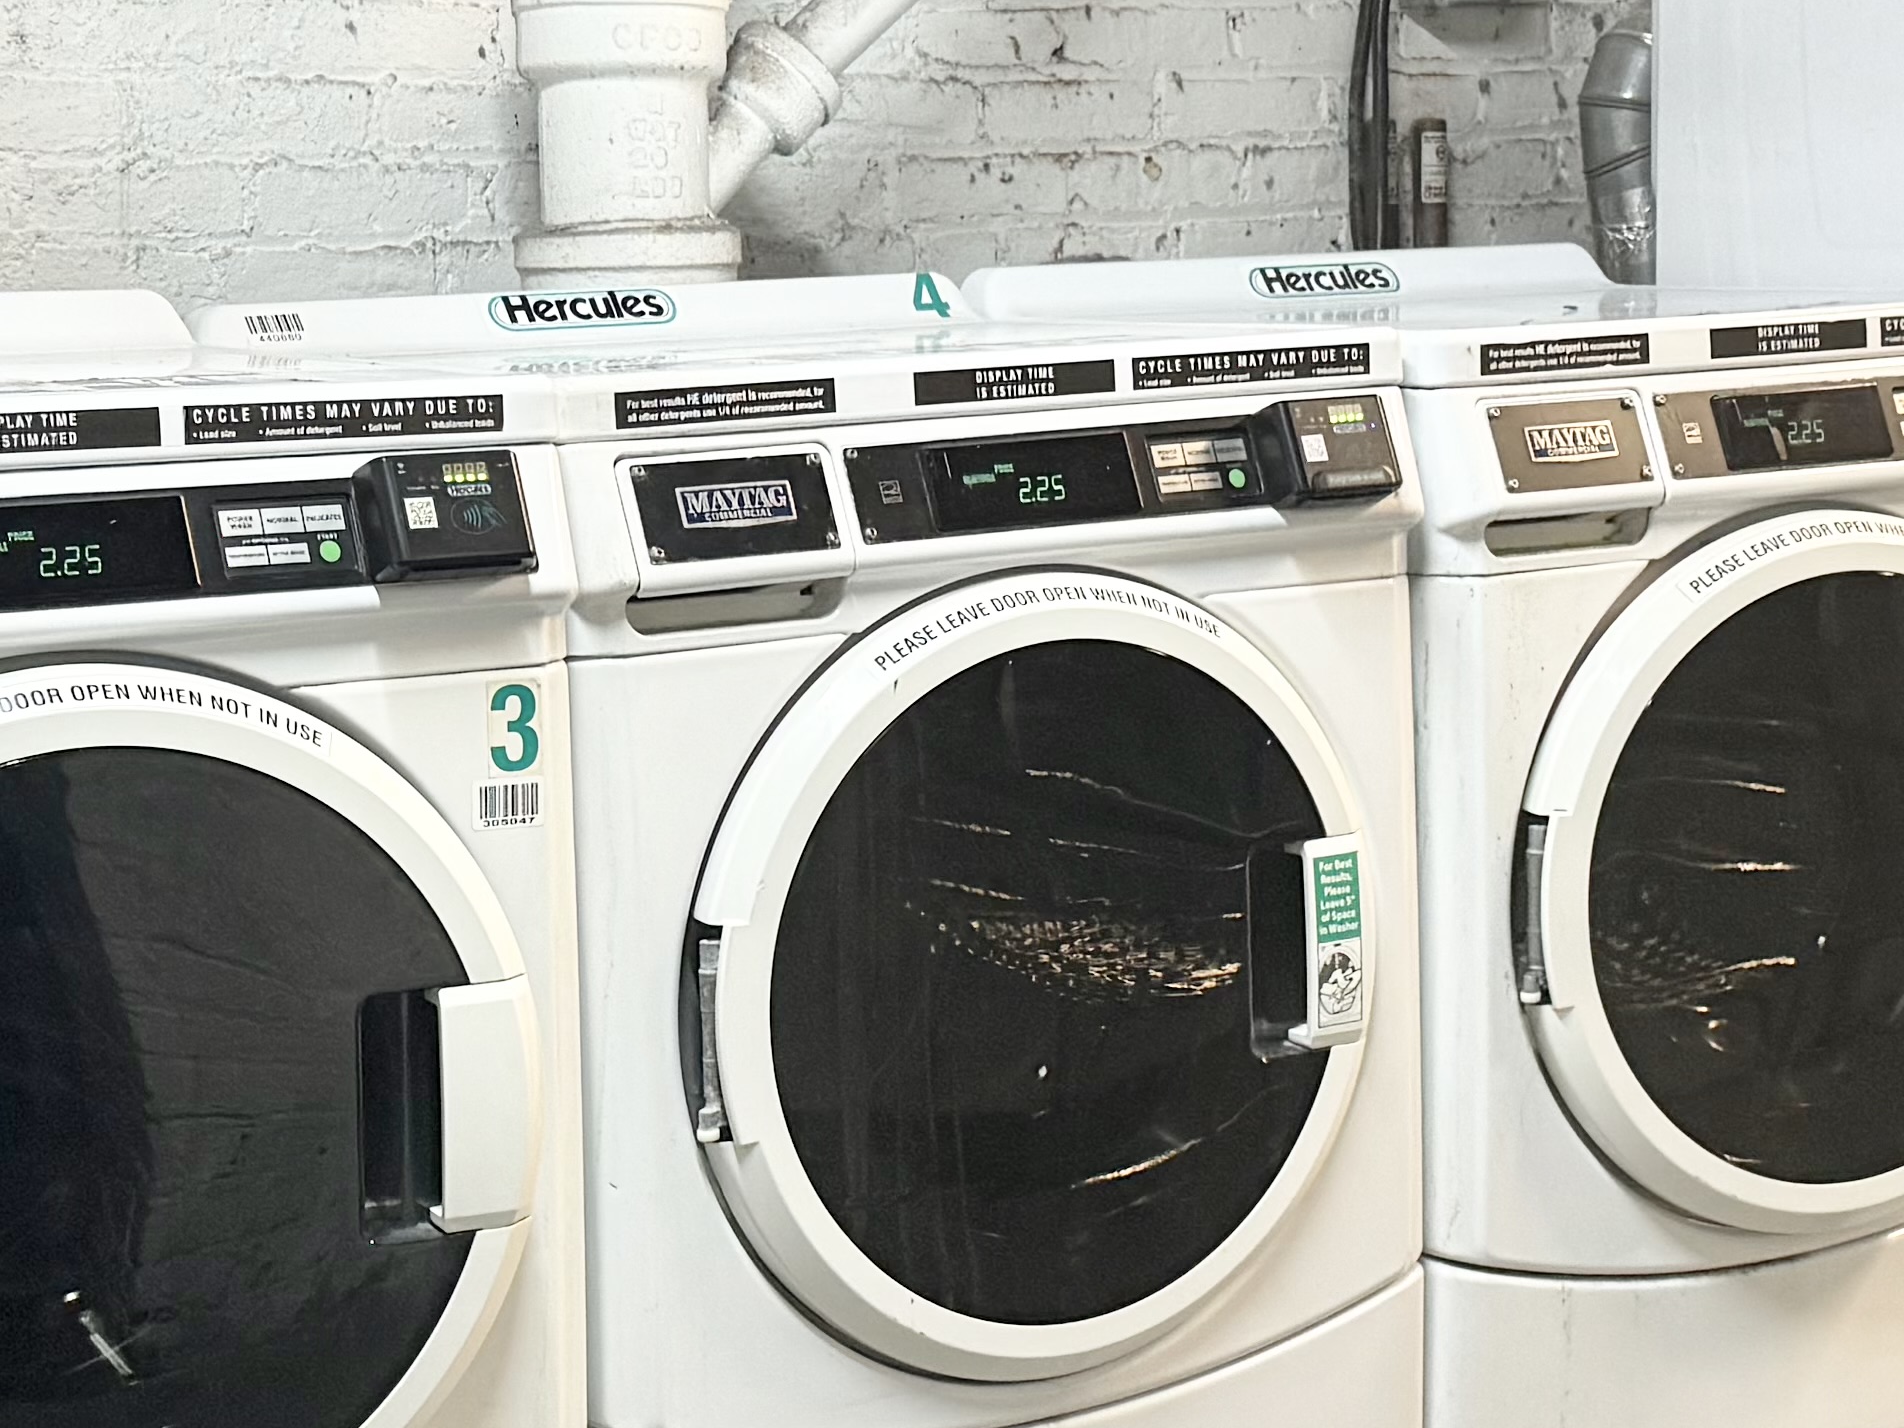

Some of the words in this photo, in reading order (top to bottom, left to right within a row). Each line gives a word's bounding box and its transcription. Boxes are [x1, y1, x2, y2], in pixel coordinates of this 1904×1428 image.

[1259, 263, 1391, 294] Hercules
[500, 290, 664, 325] Hercules
[912, 272, 952, 318] 4
[1756, 325, 1796, 339] DISPLAY
[1797, 323, 1820, 336] TIME
[1757, 340, 1768, 352] IS
[1769, 336, 1821, 351] ESTIMATED
[1138, 359, 1183, 375] CYCLE
[1188, 355, 1232, 372] TIMES
[1237, 352, 1266, 369] MAY
[1270, 349, 1306, 367] VARY
[1310, 348, 1338, 365] DUE
[975, 368, 1023, 385] DISPLAY
[1026, 365, 1056, 381] TIME
[976, 384, 991, 400] IS
[992, 380, 1056, 399] ESTIMATED
[39, 412, 78, 428] TIME
[192, 406, 252, 424] CYCLE
[260, 404, 318, 422] TIMES
[325, 402, 362, 420] MAY
[370, 400, 415, 418] VARY
[424, 399, 458, 416] DUE
[466, 398, 494, 414] TO:
[1529, 424, 1612, 452] MAYTAG
[1787, 419, 1825, 445] 2.25
[683, 485, 788, 516] MAYTAG
[1018, 474, 1066, 504] 2.25
[704, 507, 774, 522] COMMERCIAL
[38, 544, 103, 578] 2.25
[1689, 554, 1746, 594] PLEASE
[1742, 533, 1791, 562] LEAVE
[1789, 523, 1832, 545] DOOR
[1835, 520, 1874, 535] OPEN
[874, 625, 939, 671] PLEASE
[936, 600, 991, 635] LEAVE
[990, 588, 1041, 613] DOOR
[1042, 586, 1087, 602] OPEN
[1090, 586, 1138, 607] WHEN
[1141, 595, 1170, 617] NOT
[1174, 606, 1191, 623] IN
[1194, 614, 1222, 639] USE
[70, 683, 131, 703] OPEN
[137, 684, 203, 708] WHEN
[210, 696, 252, 720] NOT
[258, 706, 278, 729] IN
[285, 717, 323, 748] USE
[490, 683, 539, 772] 3
[1318, 860, 1334, 873] For
[1333, 858, 1354, 871] Best
[1323, 884, 1352, 898] Please
[1320, 898, 1346, 912] Leave
[1320, 911, 1332, 924] of
[1331, 909, 1357, 924] Space
[1328, 921, 1360, 934] Washer
